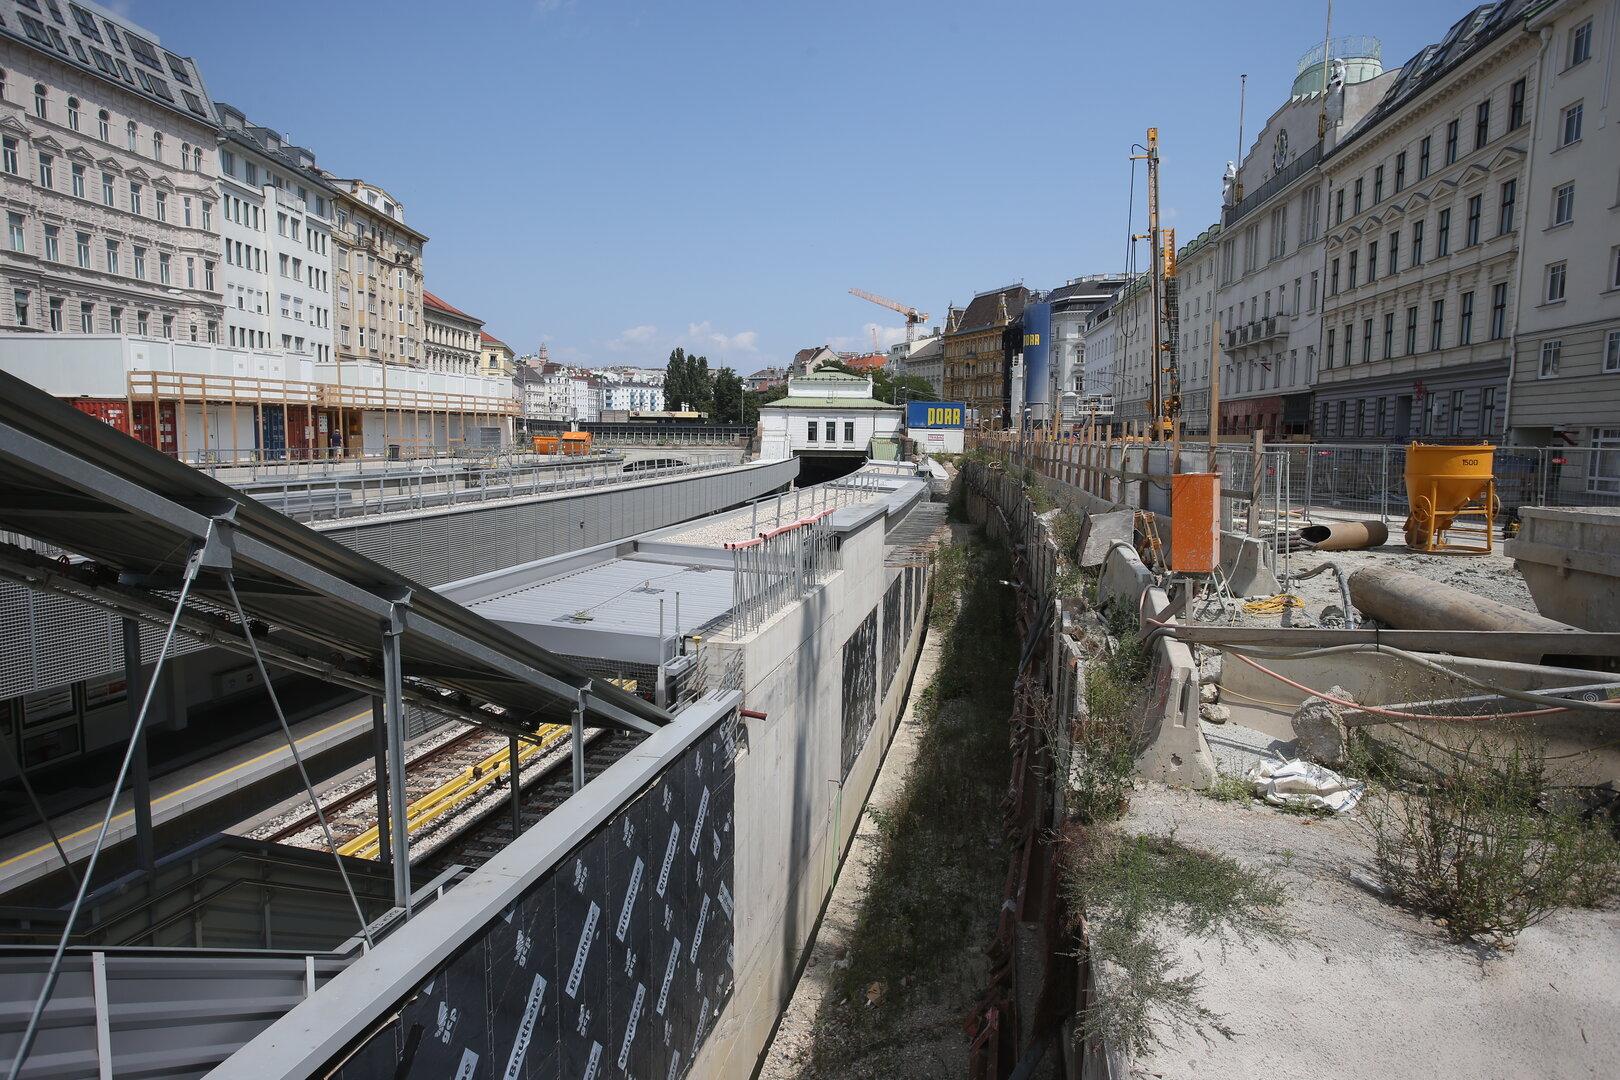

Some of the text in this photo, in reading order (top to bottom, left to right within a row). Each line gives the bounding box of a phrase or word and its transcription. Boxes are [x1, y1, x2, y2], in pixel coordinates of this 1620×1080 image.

[928, 407, 960, 426] PORR
[619, 867, 641, 934] Bituthene
[569, 912, 597, 990] Bituthene
[508, 986, 543, 1078] Bituthene
